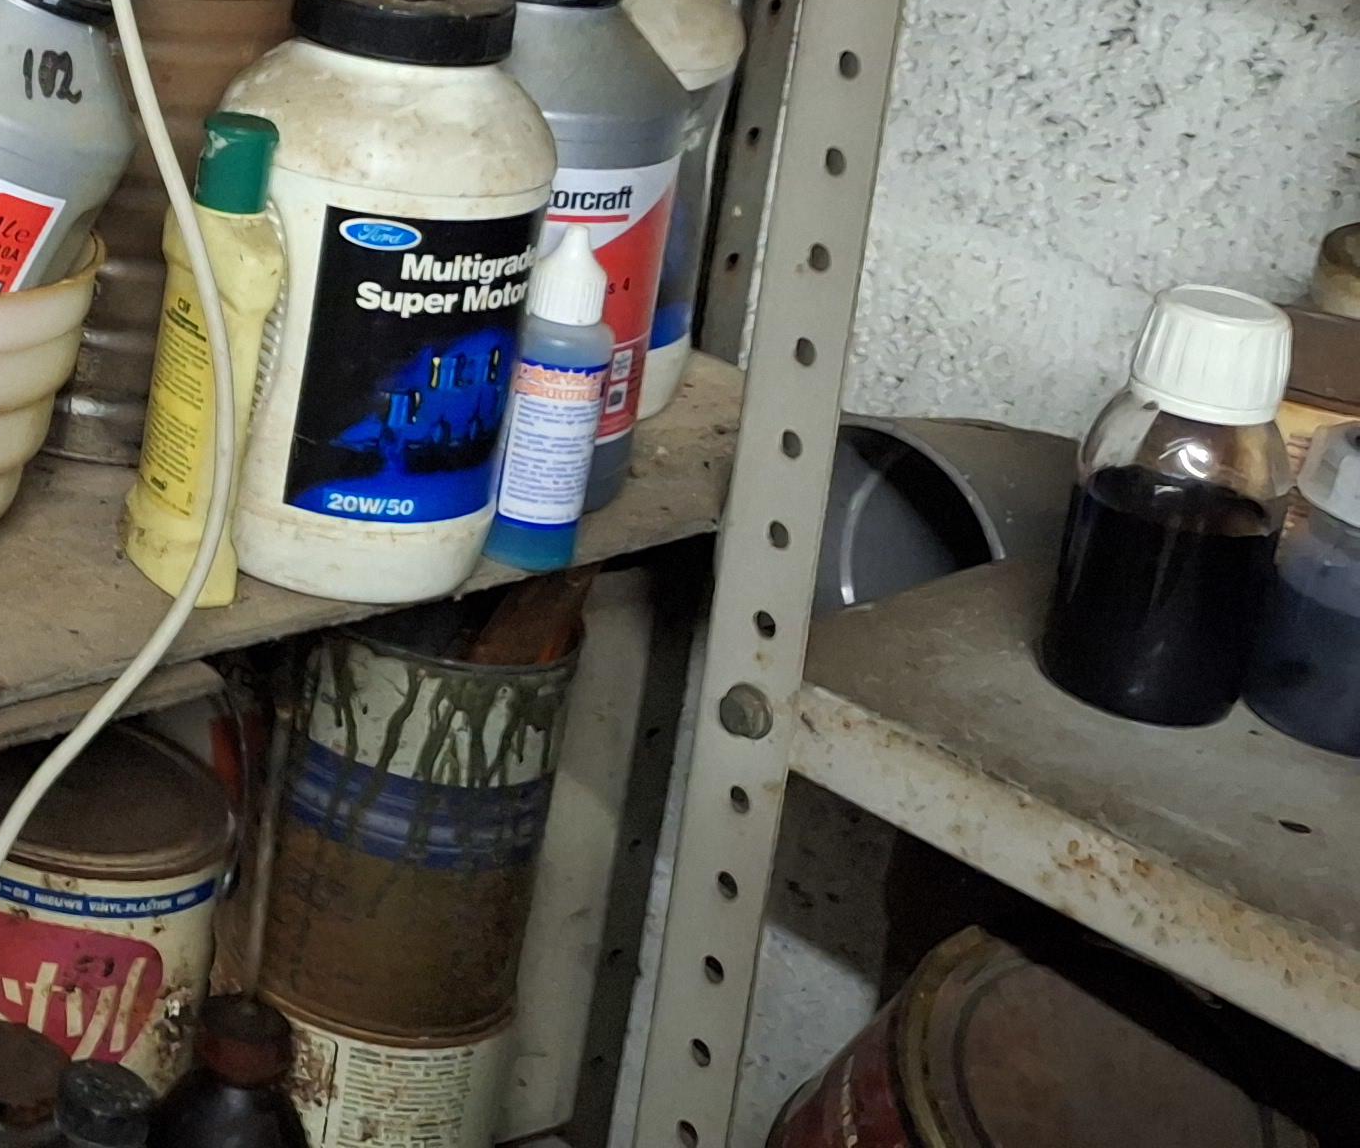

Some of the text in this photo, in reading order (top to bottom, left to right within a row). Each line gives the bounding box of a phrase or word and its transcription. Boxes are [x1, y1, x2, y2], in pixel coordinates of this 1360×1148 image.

[22, 47, 83, 105] 102
[355, 280, 528, 319] Super Motor
[327, 491, 415, 518] 20W/50
